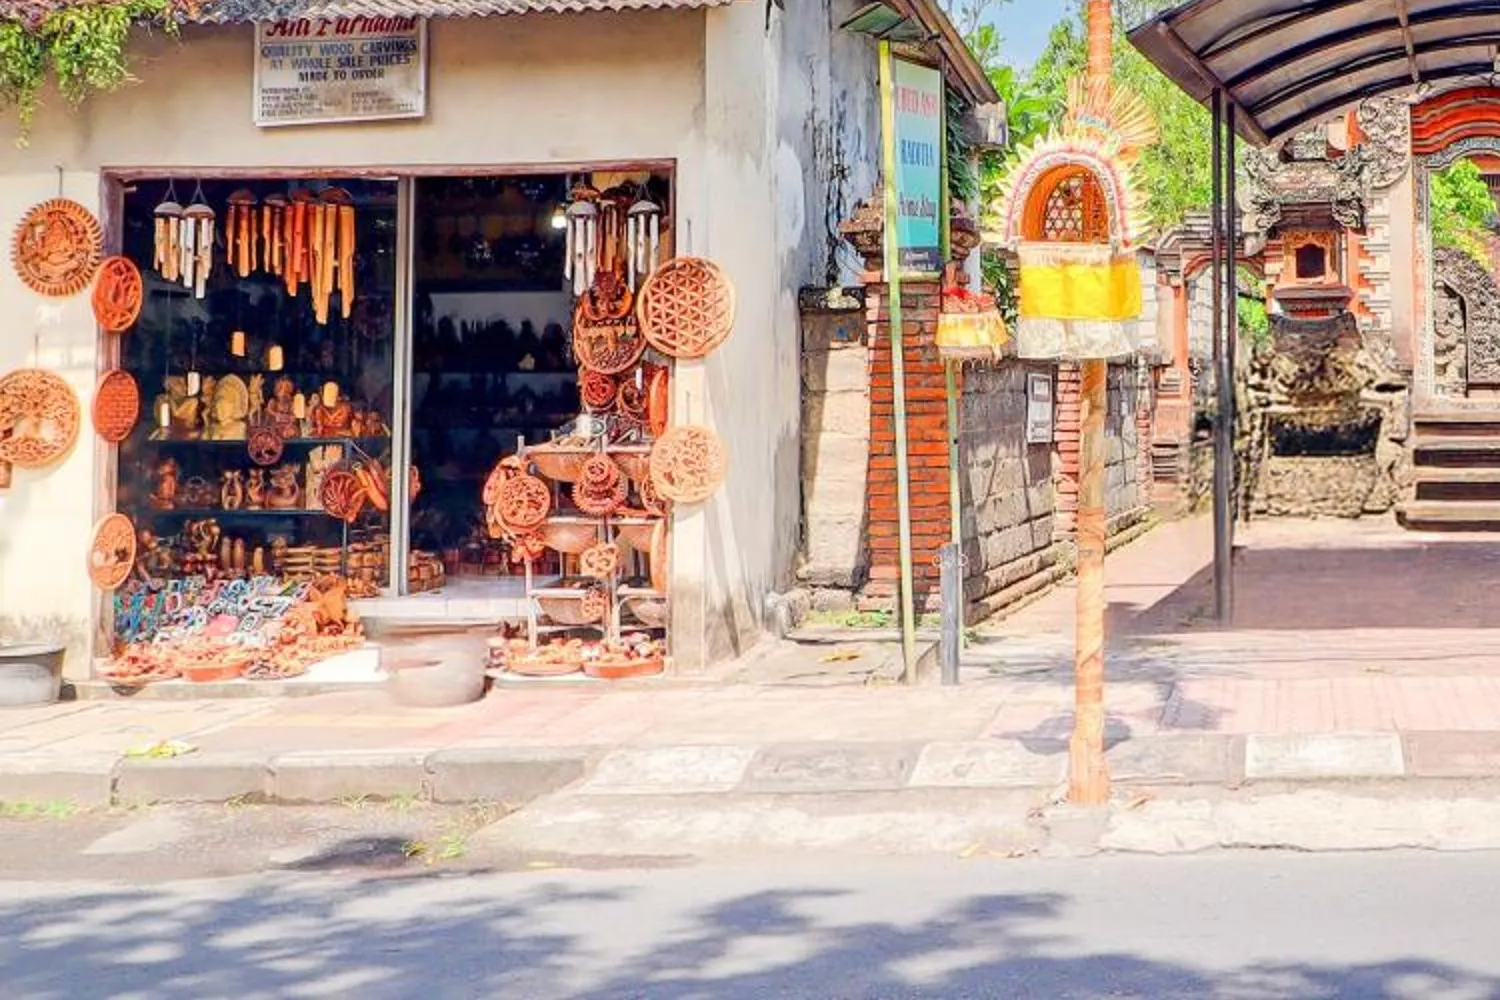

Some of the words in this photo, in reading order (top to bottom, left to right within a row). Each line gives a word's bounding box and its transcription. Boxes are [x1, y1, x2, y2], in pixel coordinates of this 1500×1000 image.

[319, 43, 354, 56] WOOD
[360, 39, 416, 54] CARVINGS
[338, 55, 363, 67] SALE
[369, 53, 411, 66] PRICES
[332, 70, 347, 80] TO
